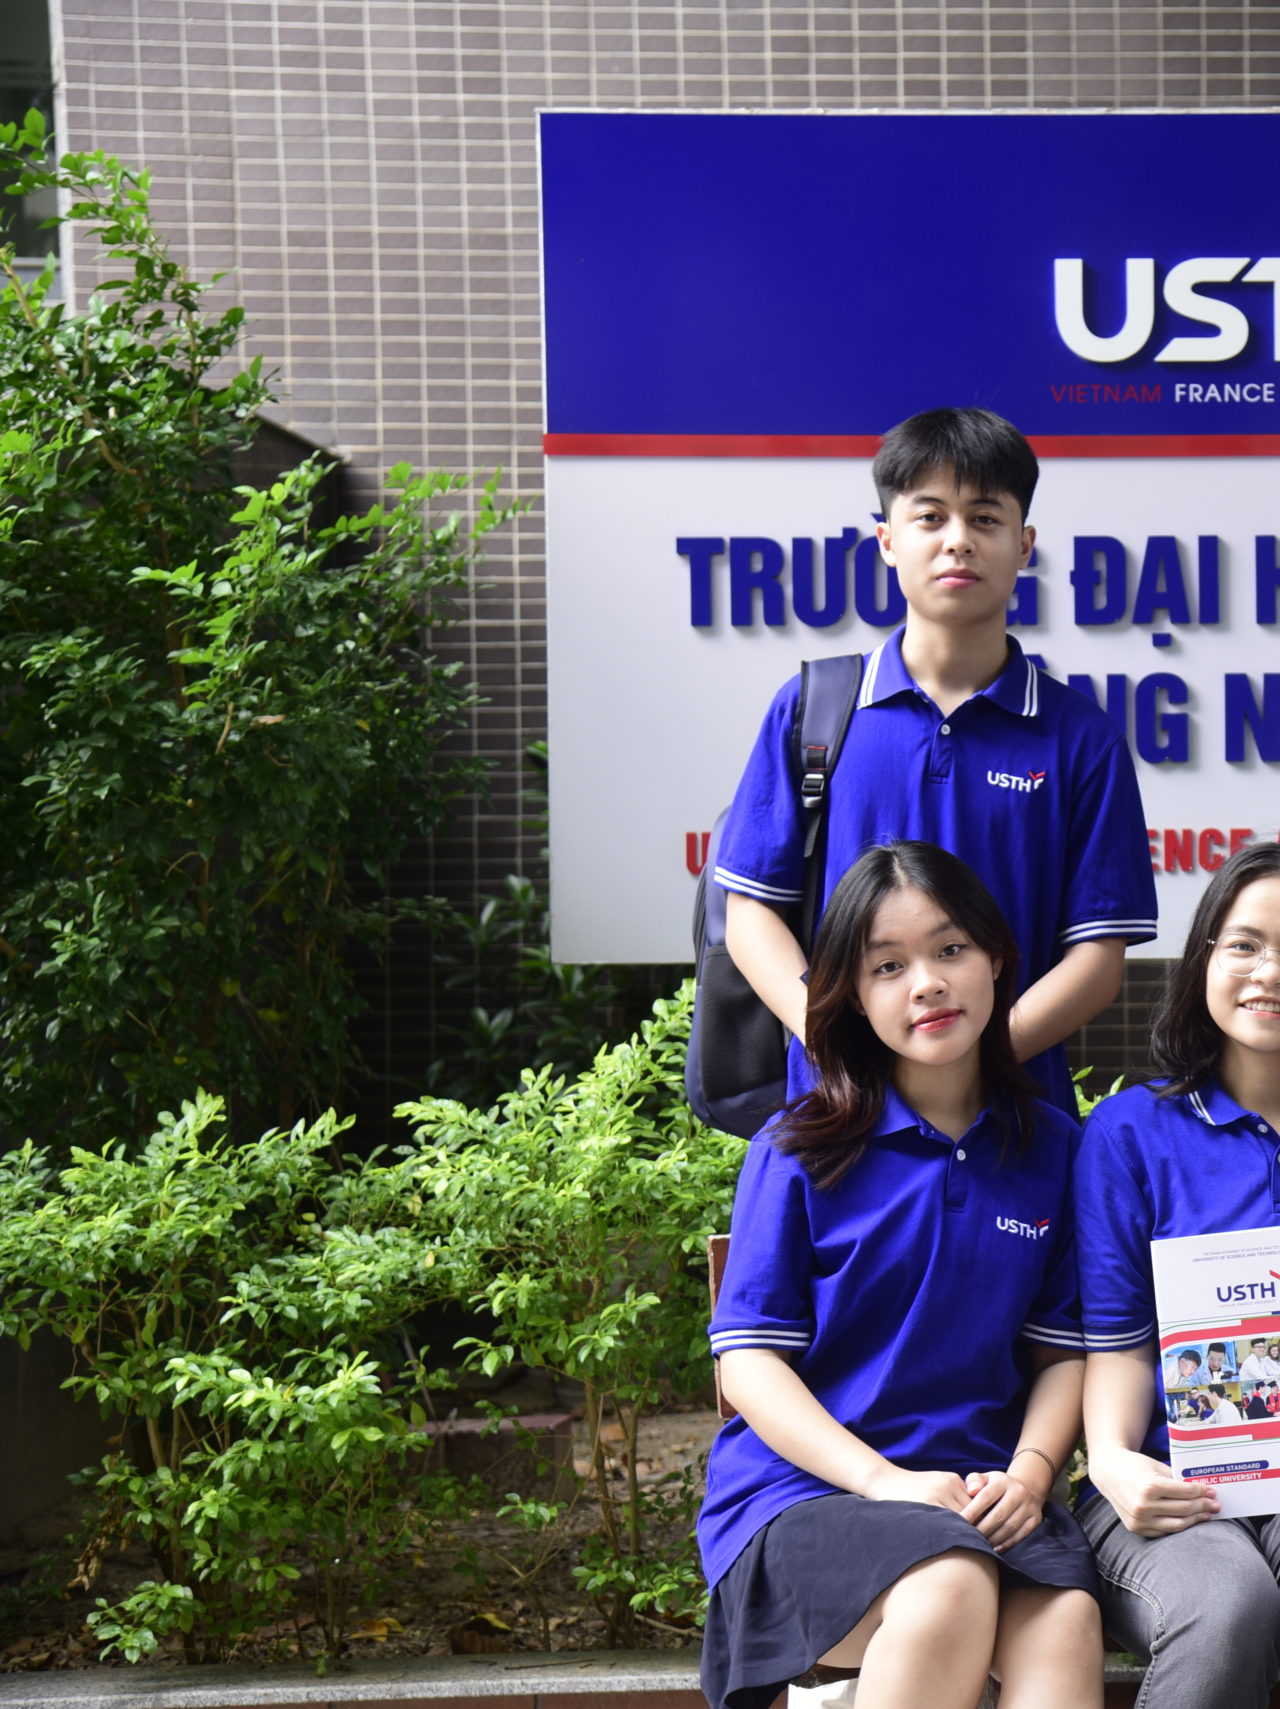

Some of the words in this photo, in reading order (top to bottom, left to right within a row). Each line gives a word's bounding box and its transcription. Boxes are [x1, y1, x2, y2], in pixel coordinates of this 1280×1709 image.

[1050, 384, 1162, 403] VIETNAM
[1174, 383, 1276, 403] FRANCE
[1069, 534, 1219, 647] ĐẠI
[987, 770, 1032, 793] USTH
[996, 1216, 1037, 1240] USTH
[1216, 1281, 1276, 1303] USTH
[1191, 1466, 1225, 1475] EUROPEAN
[1226, 1462, 1260, 1471] STANDARD
[1219, 1472, 1262, 1482] UNIVERSITY
